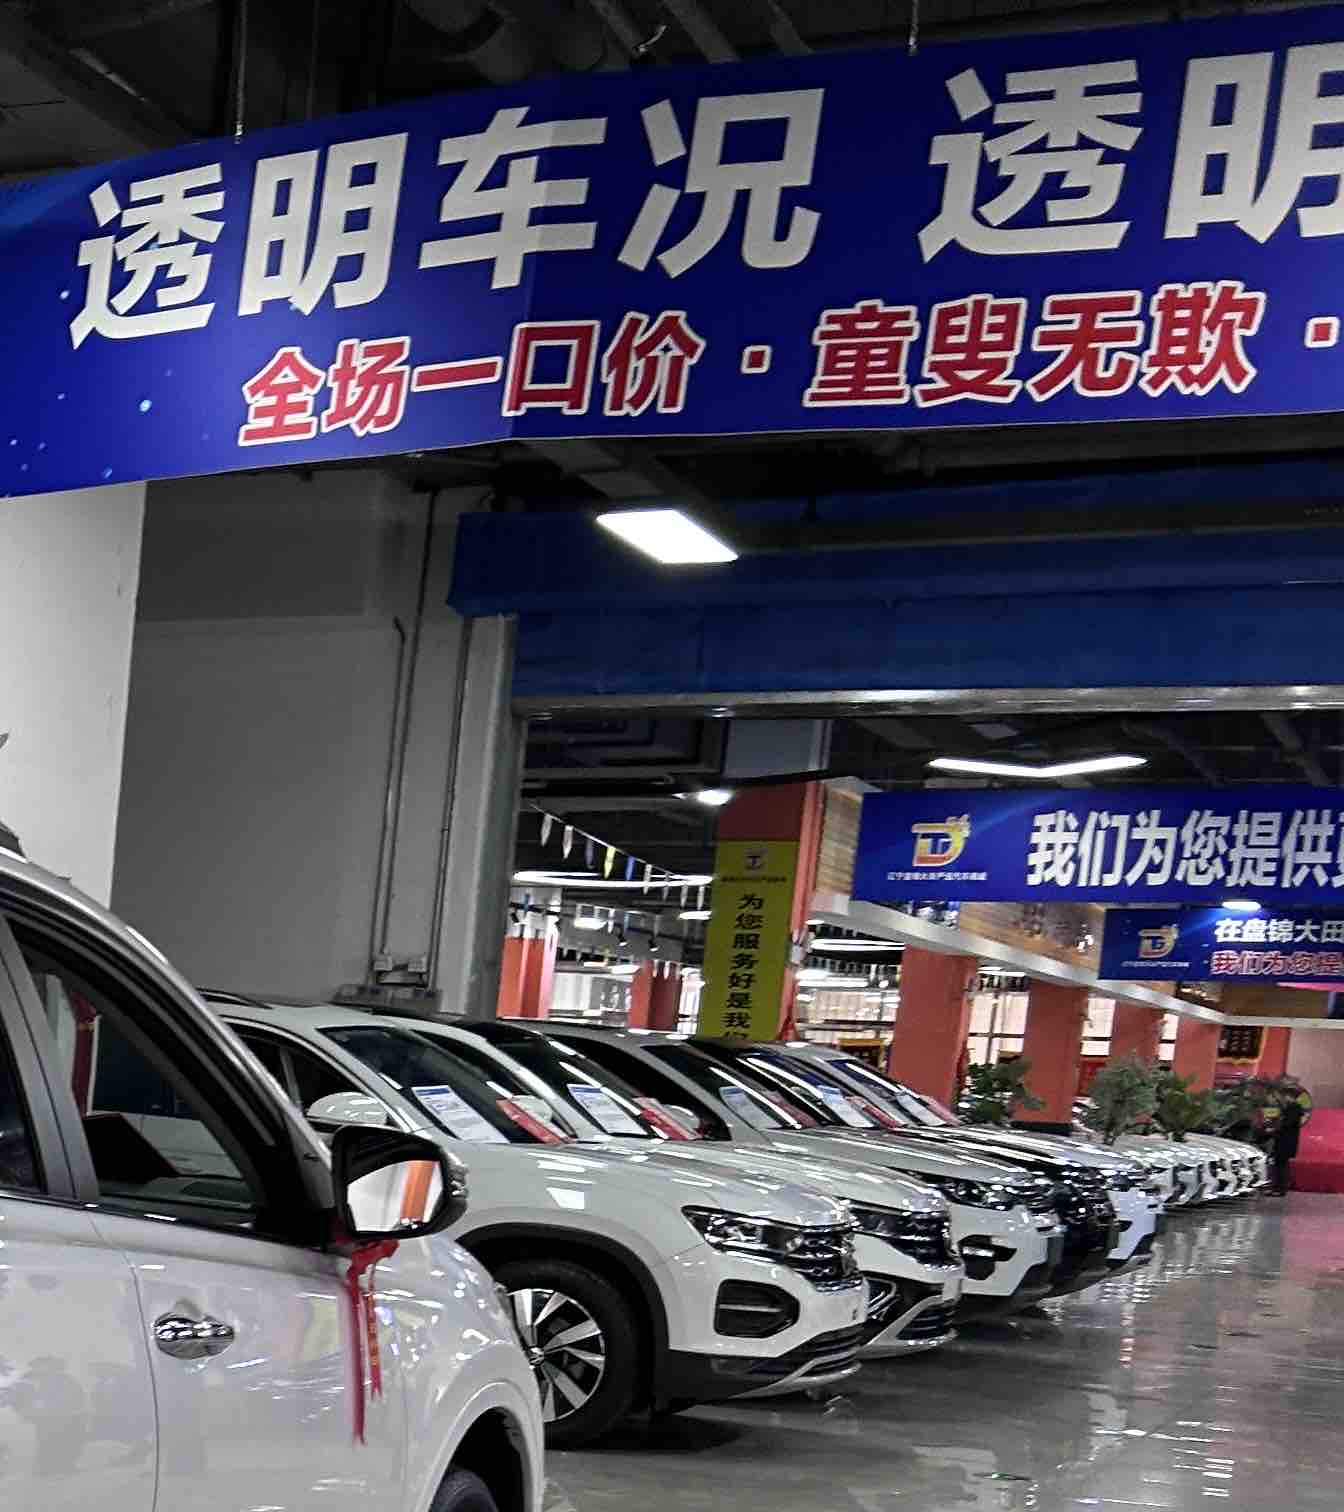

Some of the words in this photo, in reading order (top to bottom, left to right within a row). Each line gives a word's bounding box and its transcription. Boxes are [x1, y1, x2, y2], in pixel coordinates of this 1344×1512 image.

[68, 88, 827, 350] 透明车况
[917, 40, 1344, 264] 透明
[1026, 807, 1344, 888] 我们为您提供
